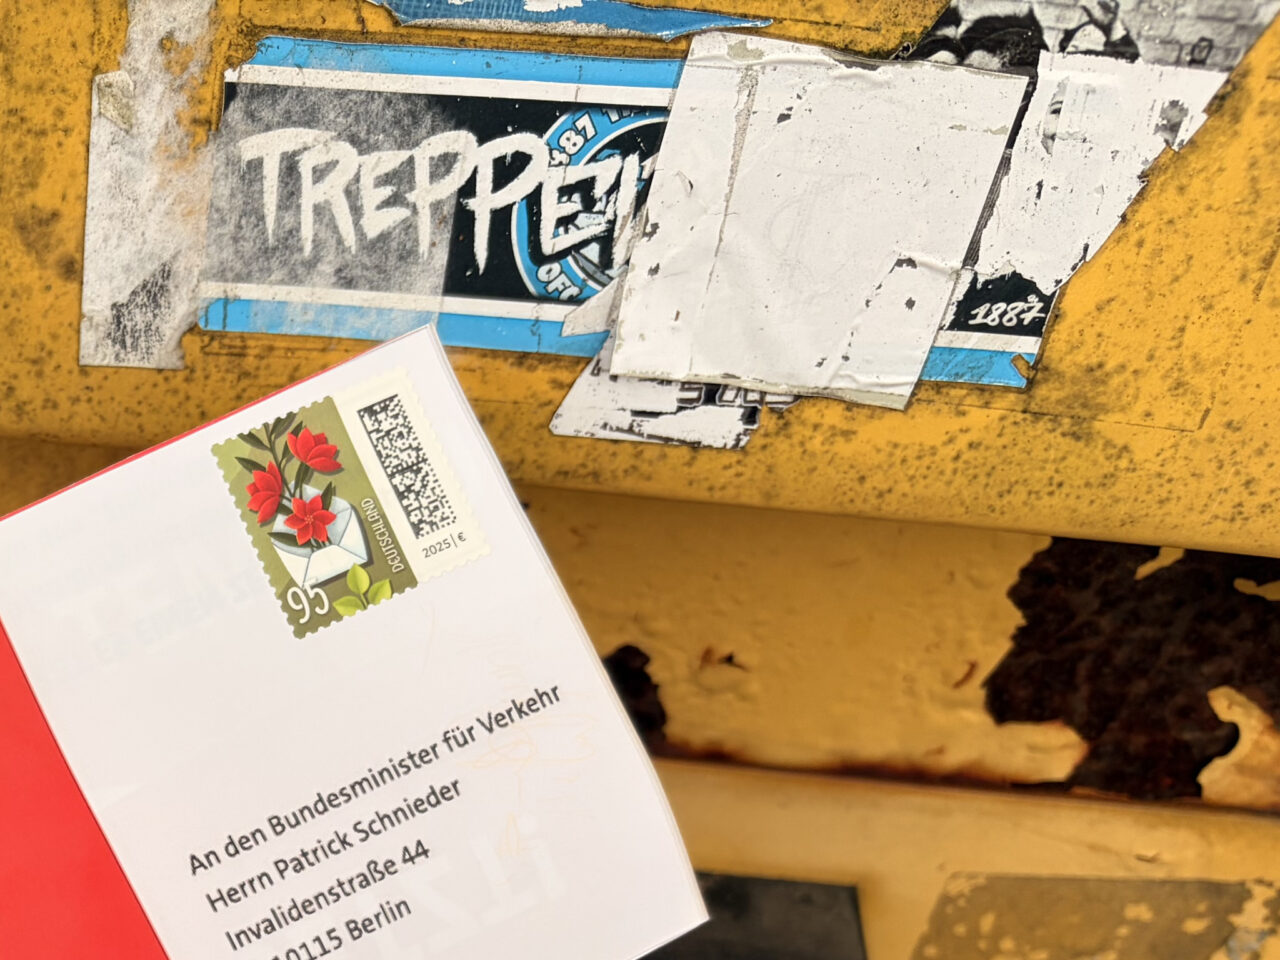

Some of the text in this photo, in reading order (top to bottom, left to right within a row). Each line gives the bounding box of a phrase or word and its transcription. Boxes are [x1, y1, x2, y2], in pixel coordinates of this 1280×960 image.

[968, 301, 1046, 327] 1887
[360, 497, 405, 573] DEUTSCHLAND
[421, 538, 452, 559] 2025
[286, 582, 330, 624] 95
[190, 685, 561, 876] An den Bundesminister für Verkehr
[206, 780, 461, 913] Herrn Patrick Schnieder
[224, 838, 431, 951] Invalidenstraße 44
[344, 900, 412, 941] Berlin
